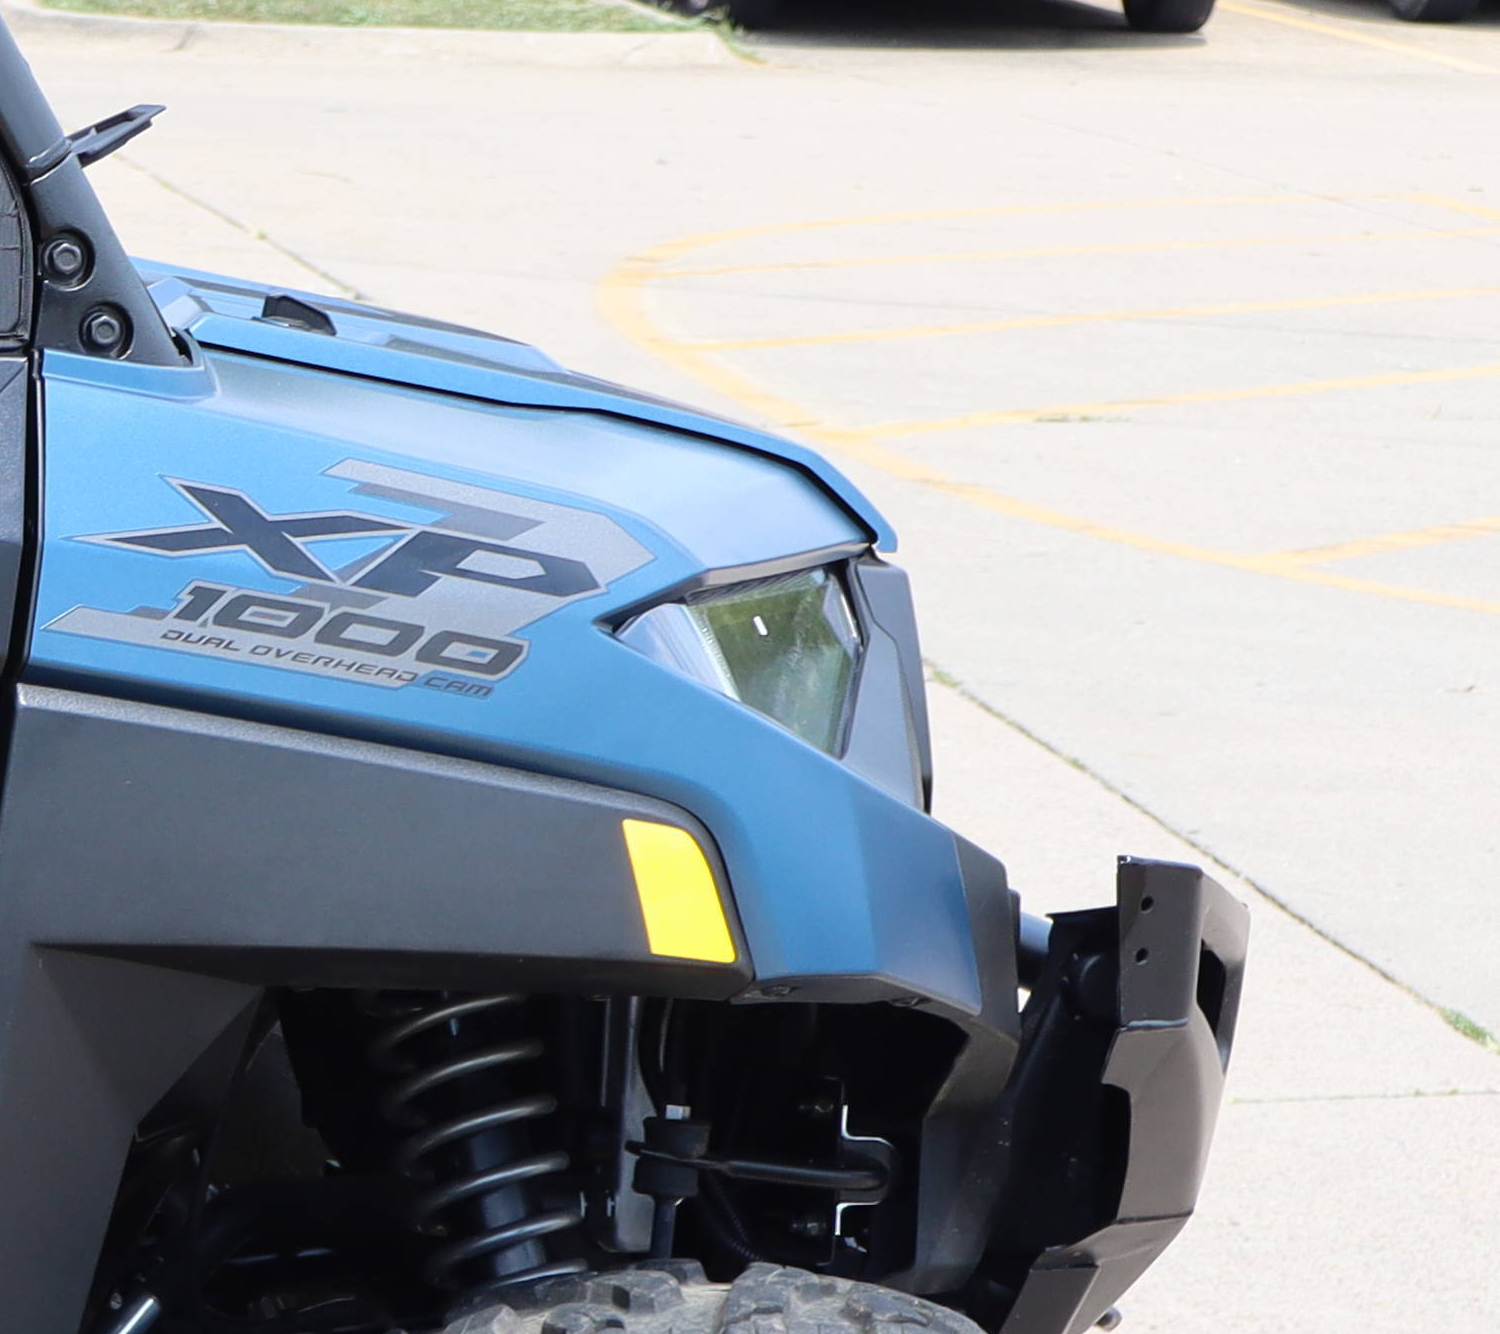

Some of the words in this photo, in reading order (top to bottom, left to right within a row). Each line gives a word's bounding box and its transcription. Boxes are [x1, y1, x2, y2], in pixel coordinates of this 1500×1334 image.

[82, 477, 606, 600] XP
[159, 628, 241, 653] DUAL
[250, 643, 419, 684] OVERHEAD
[422, 674, 495, 698] CAM
[170, 583, 526, 676] 1000
